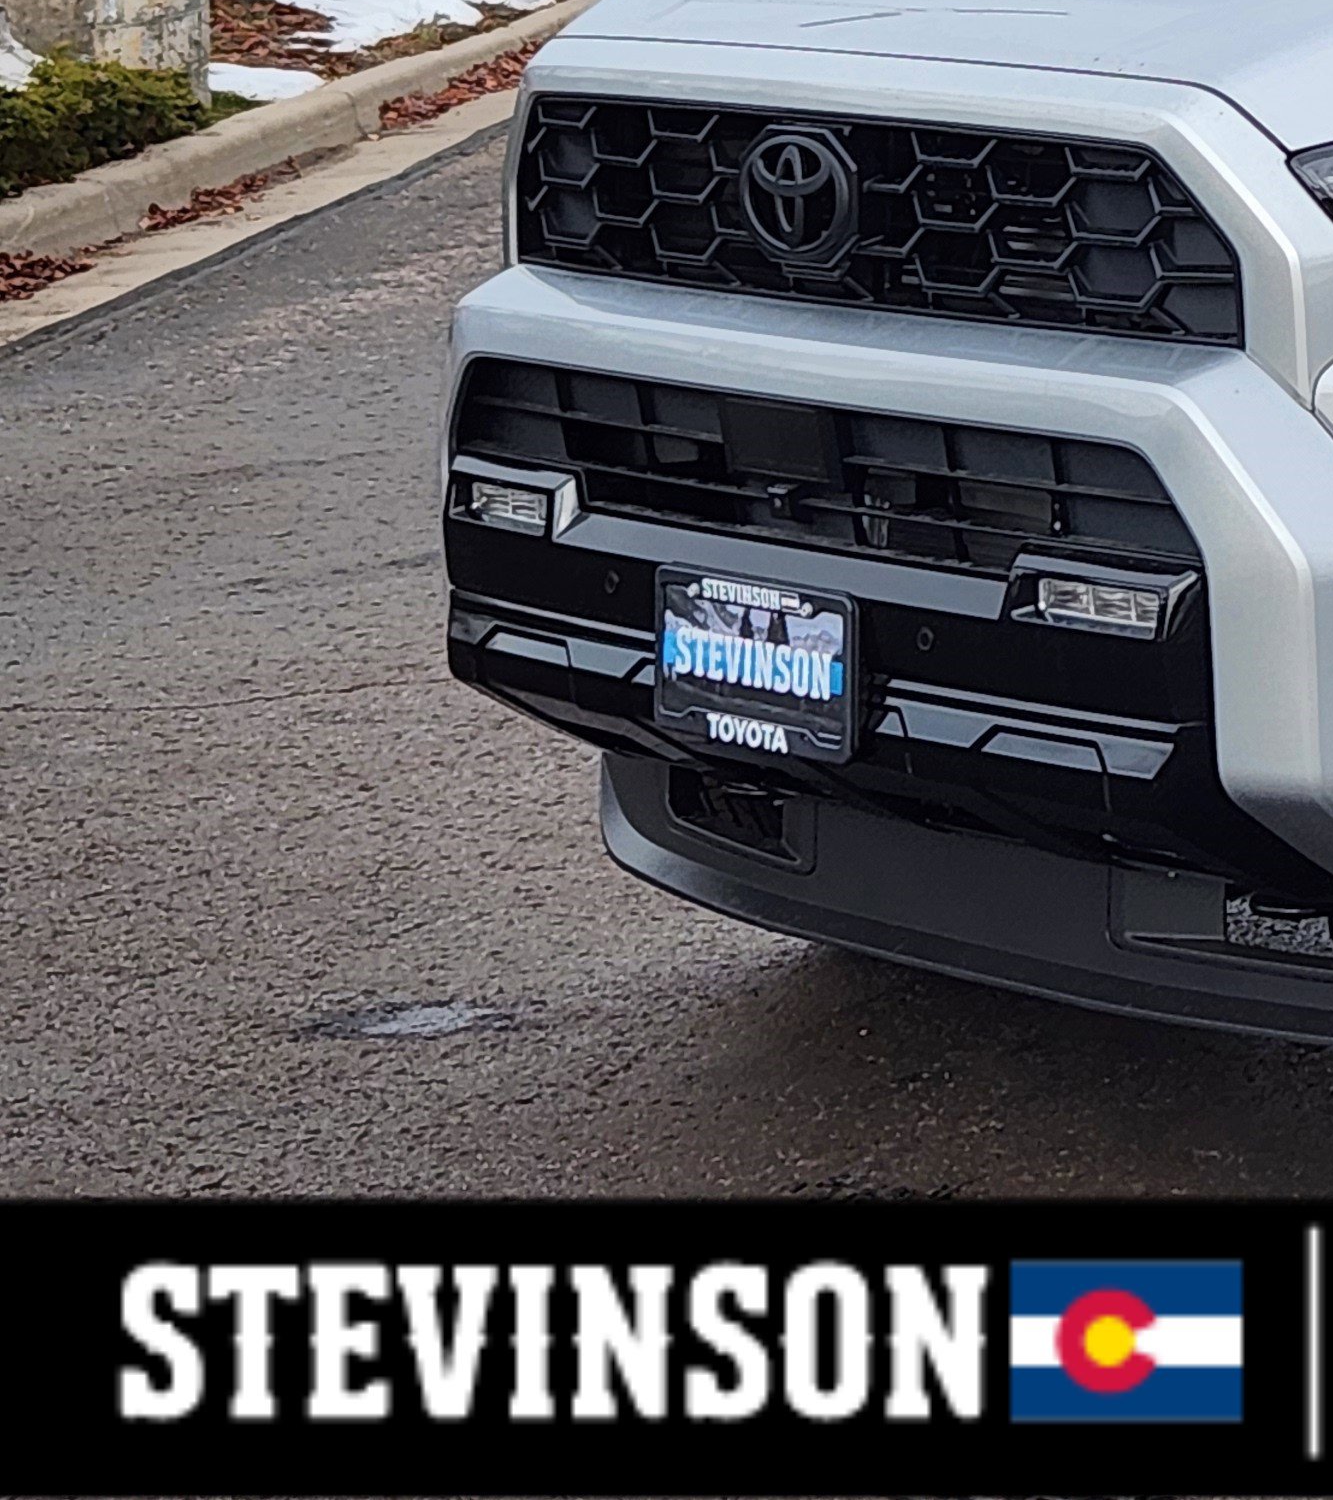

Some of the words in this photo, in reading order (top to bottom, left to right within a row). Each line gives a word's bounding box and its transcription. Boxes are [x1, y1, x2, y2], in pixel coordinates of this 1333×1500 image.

[702, 577, 780, 610] STEVINSON
[675, 627, 832, 701] STEVINSON
[707, 712, 789, 755] TOYOTA
